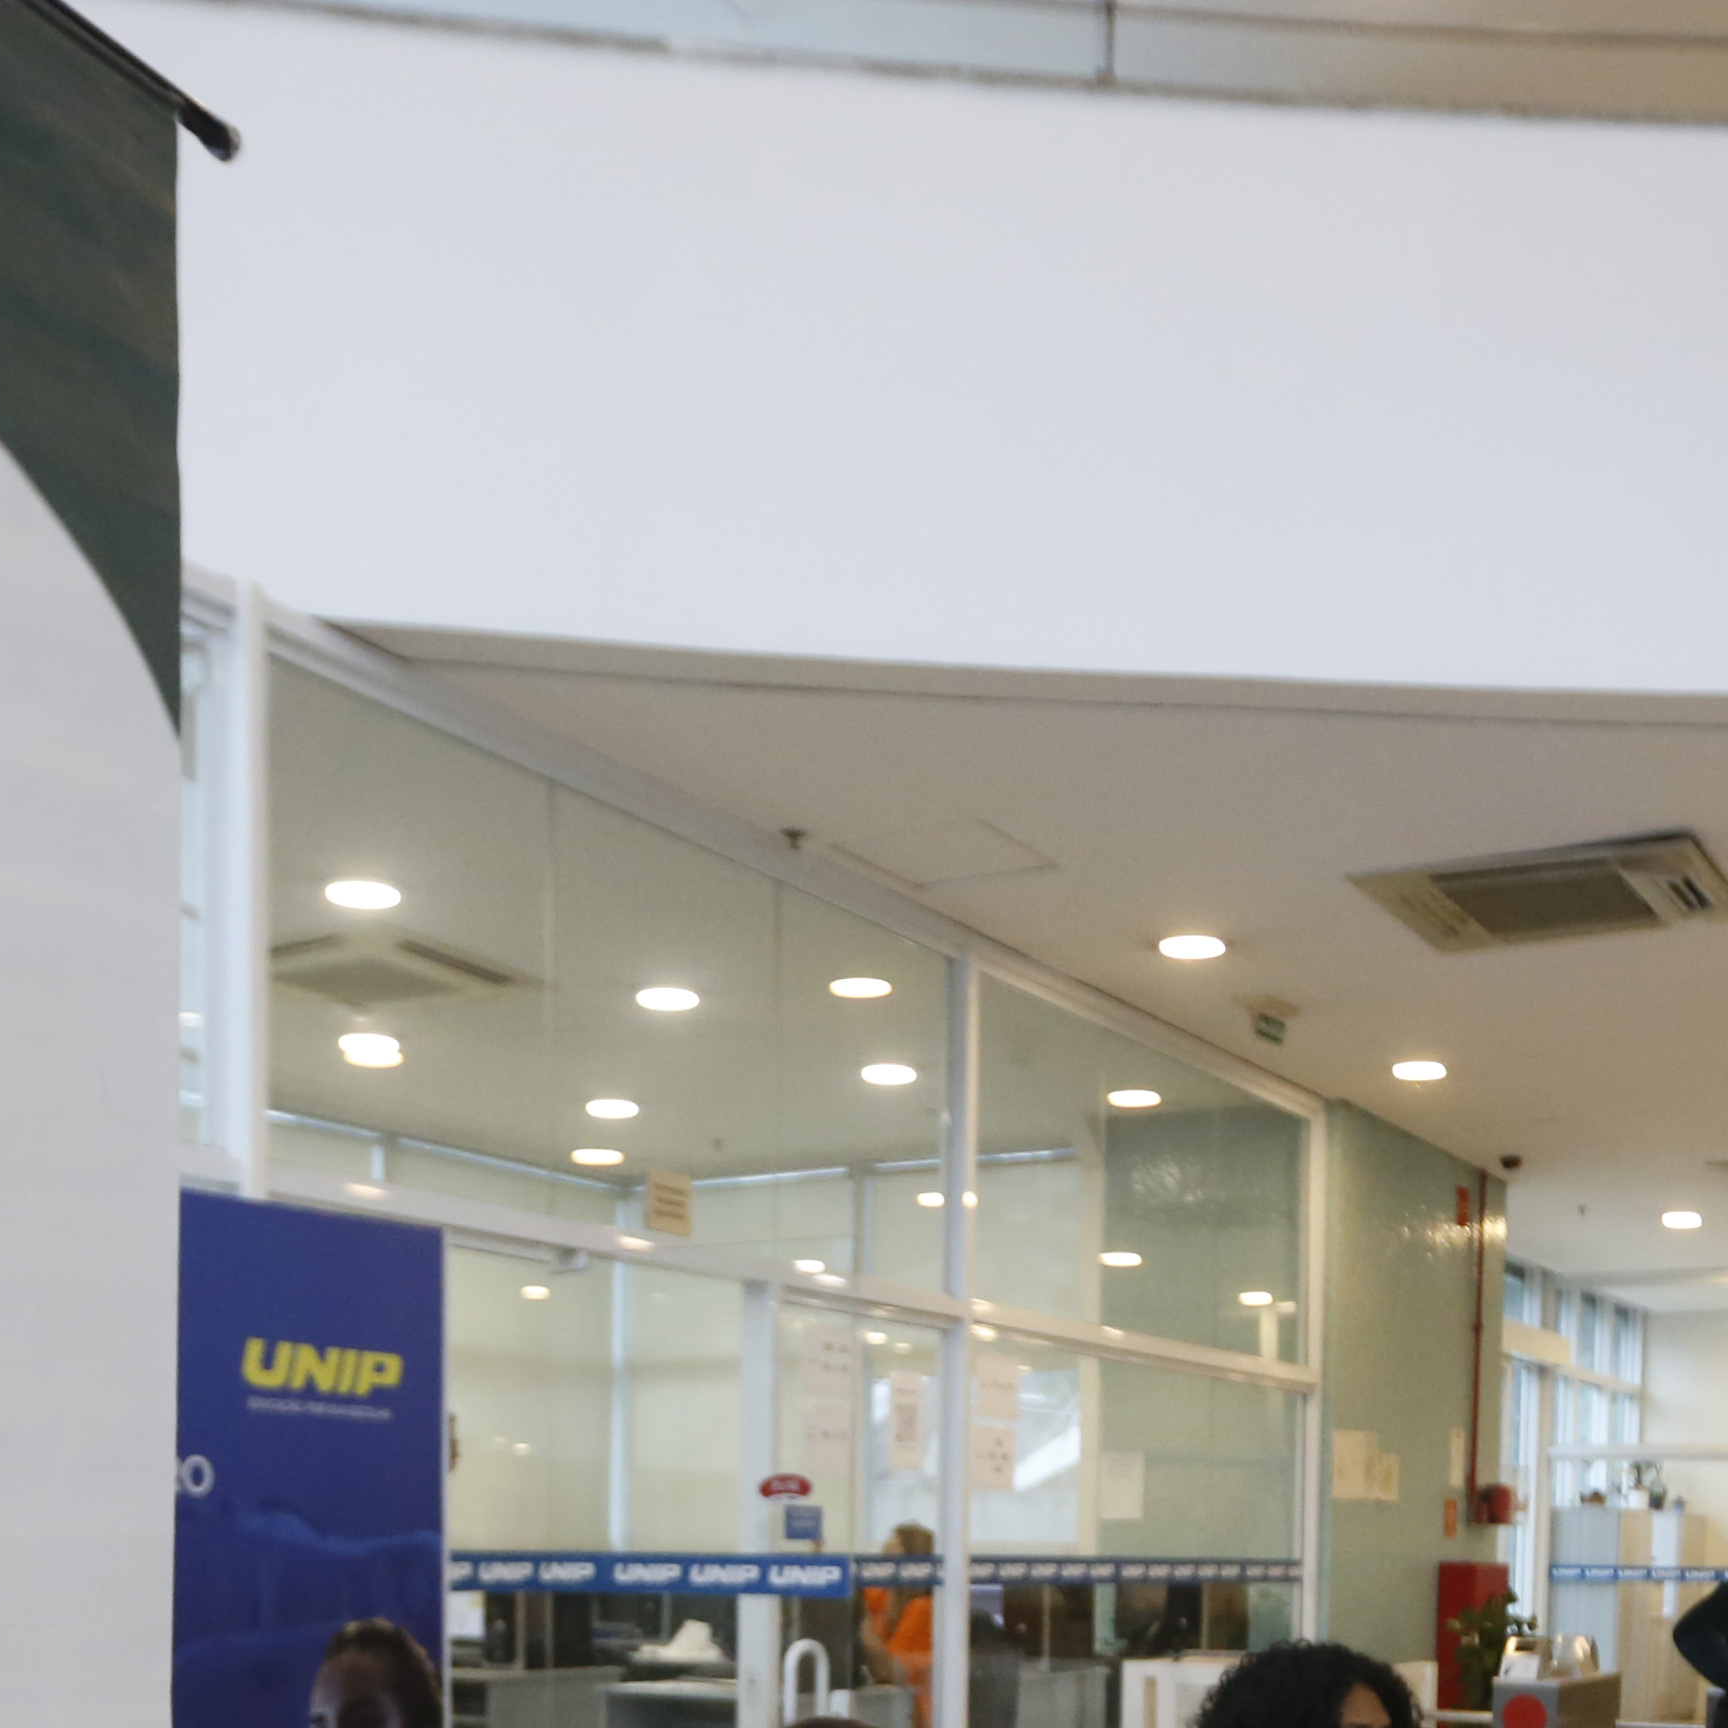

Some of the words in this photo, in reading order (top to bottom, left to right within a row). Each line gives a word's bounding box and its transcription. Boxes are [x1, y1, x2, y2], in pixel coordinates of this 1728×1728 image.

[240, 1337, 404, 1397] UNIP
[538, 1561, 597, 1583] UNIP
[613, 1562, 683, 1585] UNIP
[689, 1563, 761, 1587] UNIP
[768, 1564, 843, 1587] UNIP
